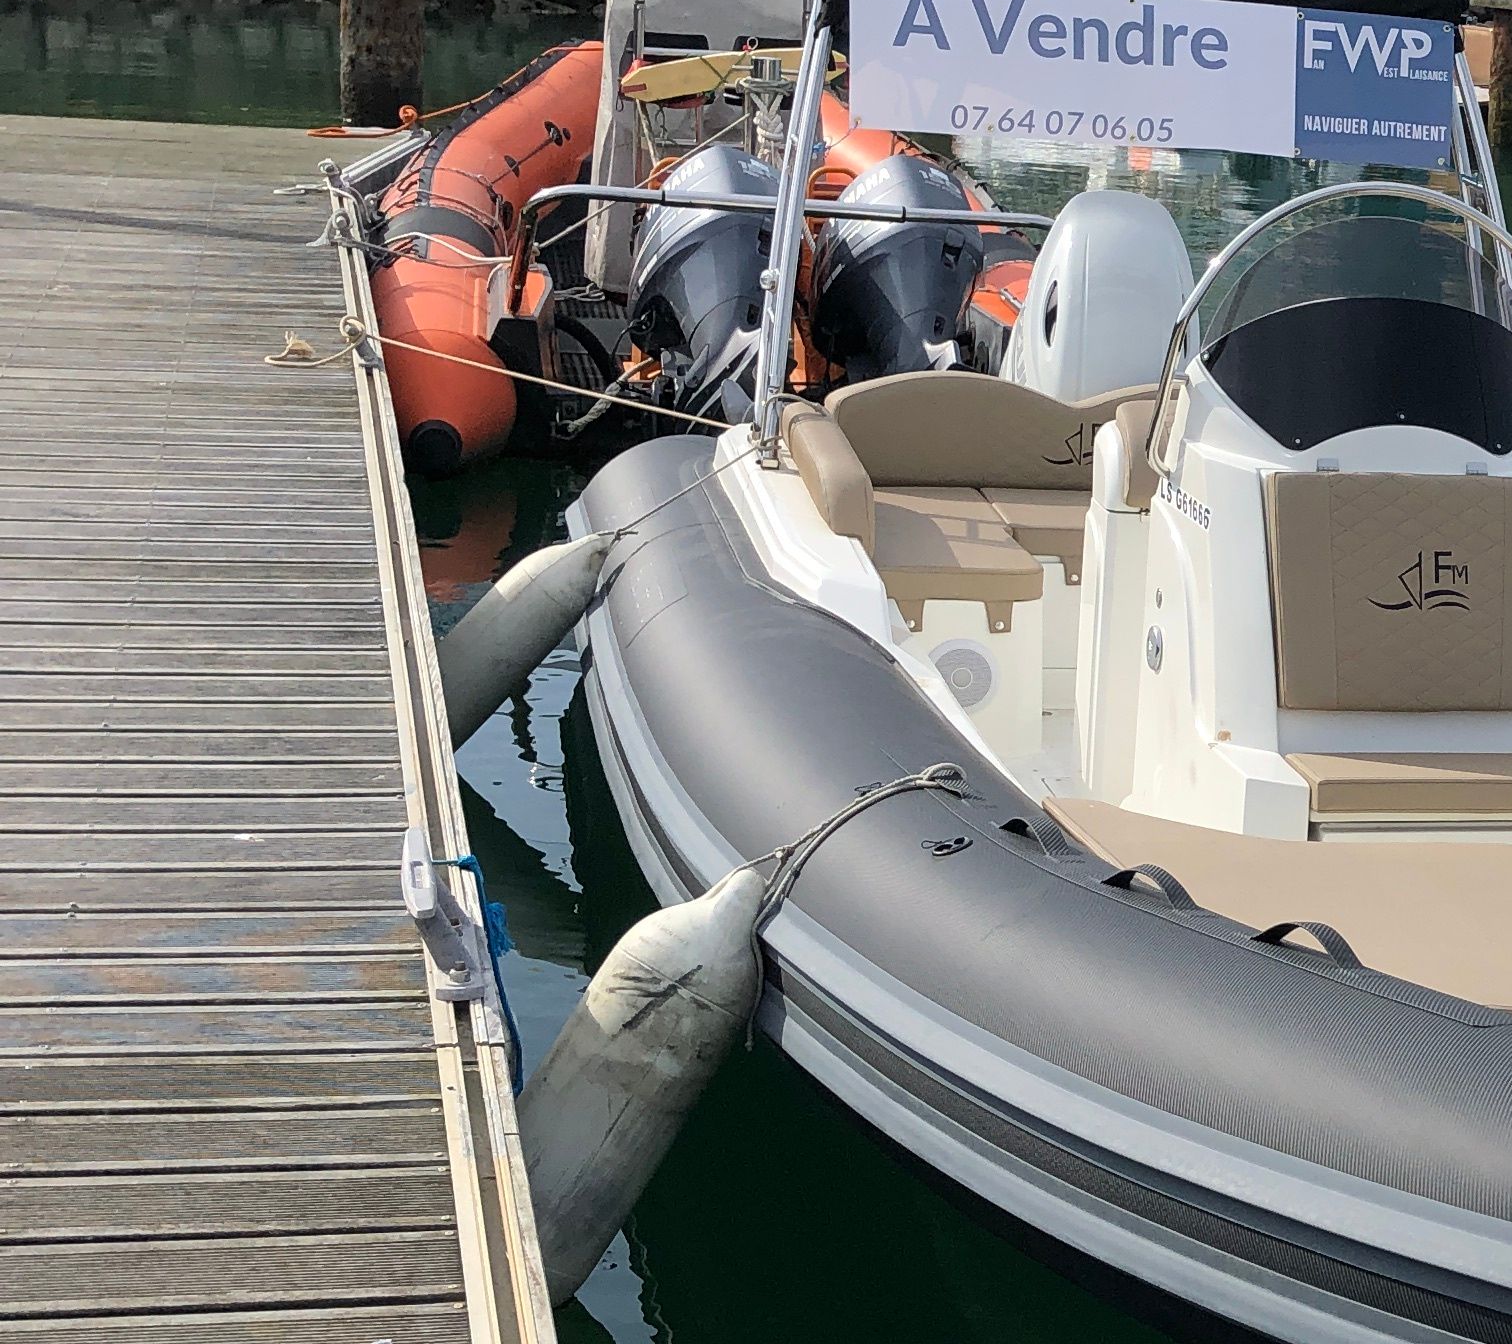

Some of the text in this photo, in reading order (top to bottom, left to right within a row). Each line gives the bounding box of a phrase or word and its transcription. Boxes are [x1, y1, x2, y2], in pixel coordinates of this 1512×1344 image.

[997, 107, 1036, 134] 64
[1045, 110, 1085, 136] 07
[1136, 117, 1175, 143] 05
[1304, 114, 1448, 143] NAVIGUER AUTREMENT
[1160, 477, 1211, 530] LS G61666
